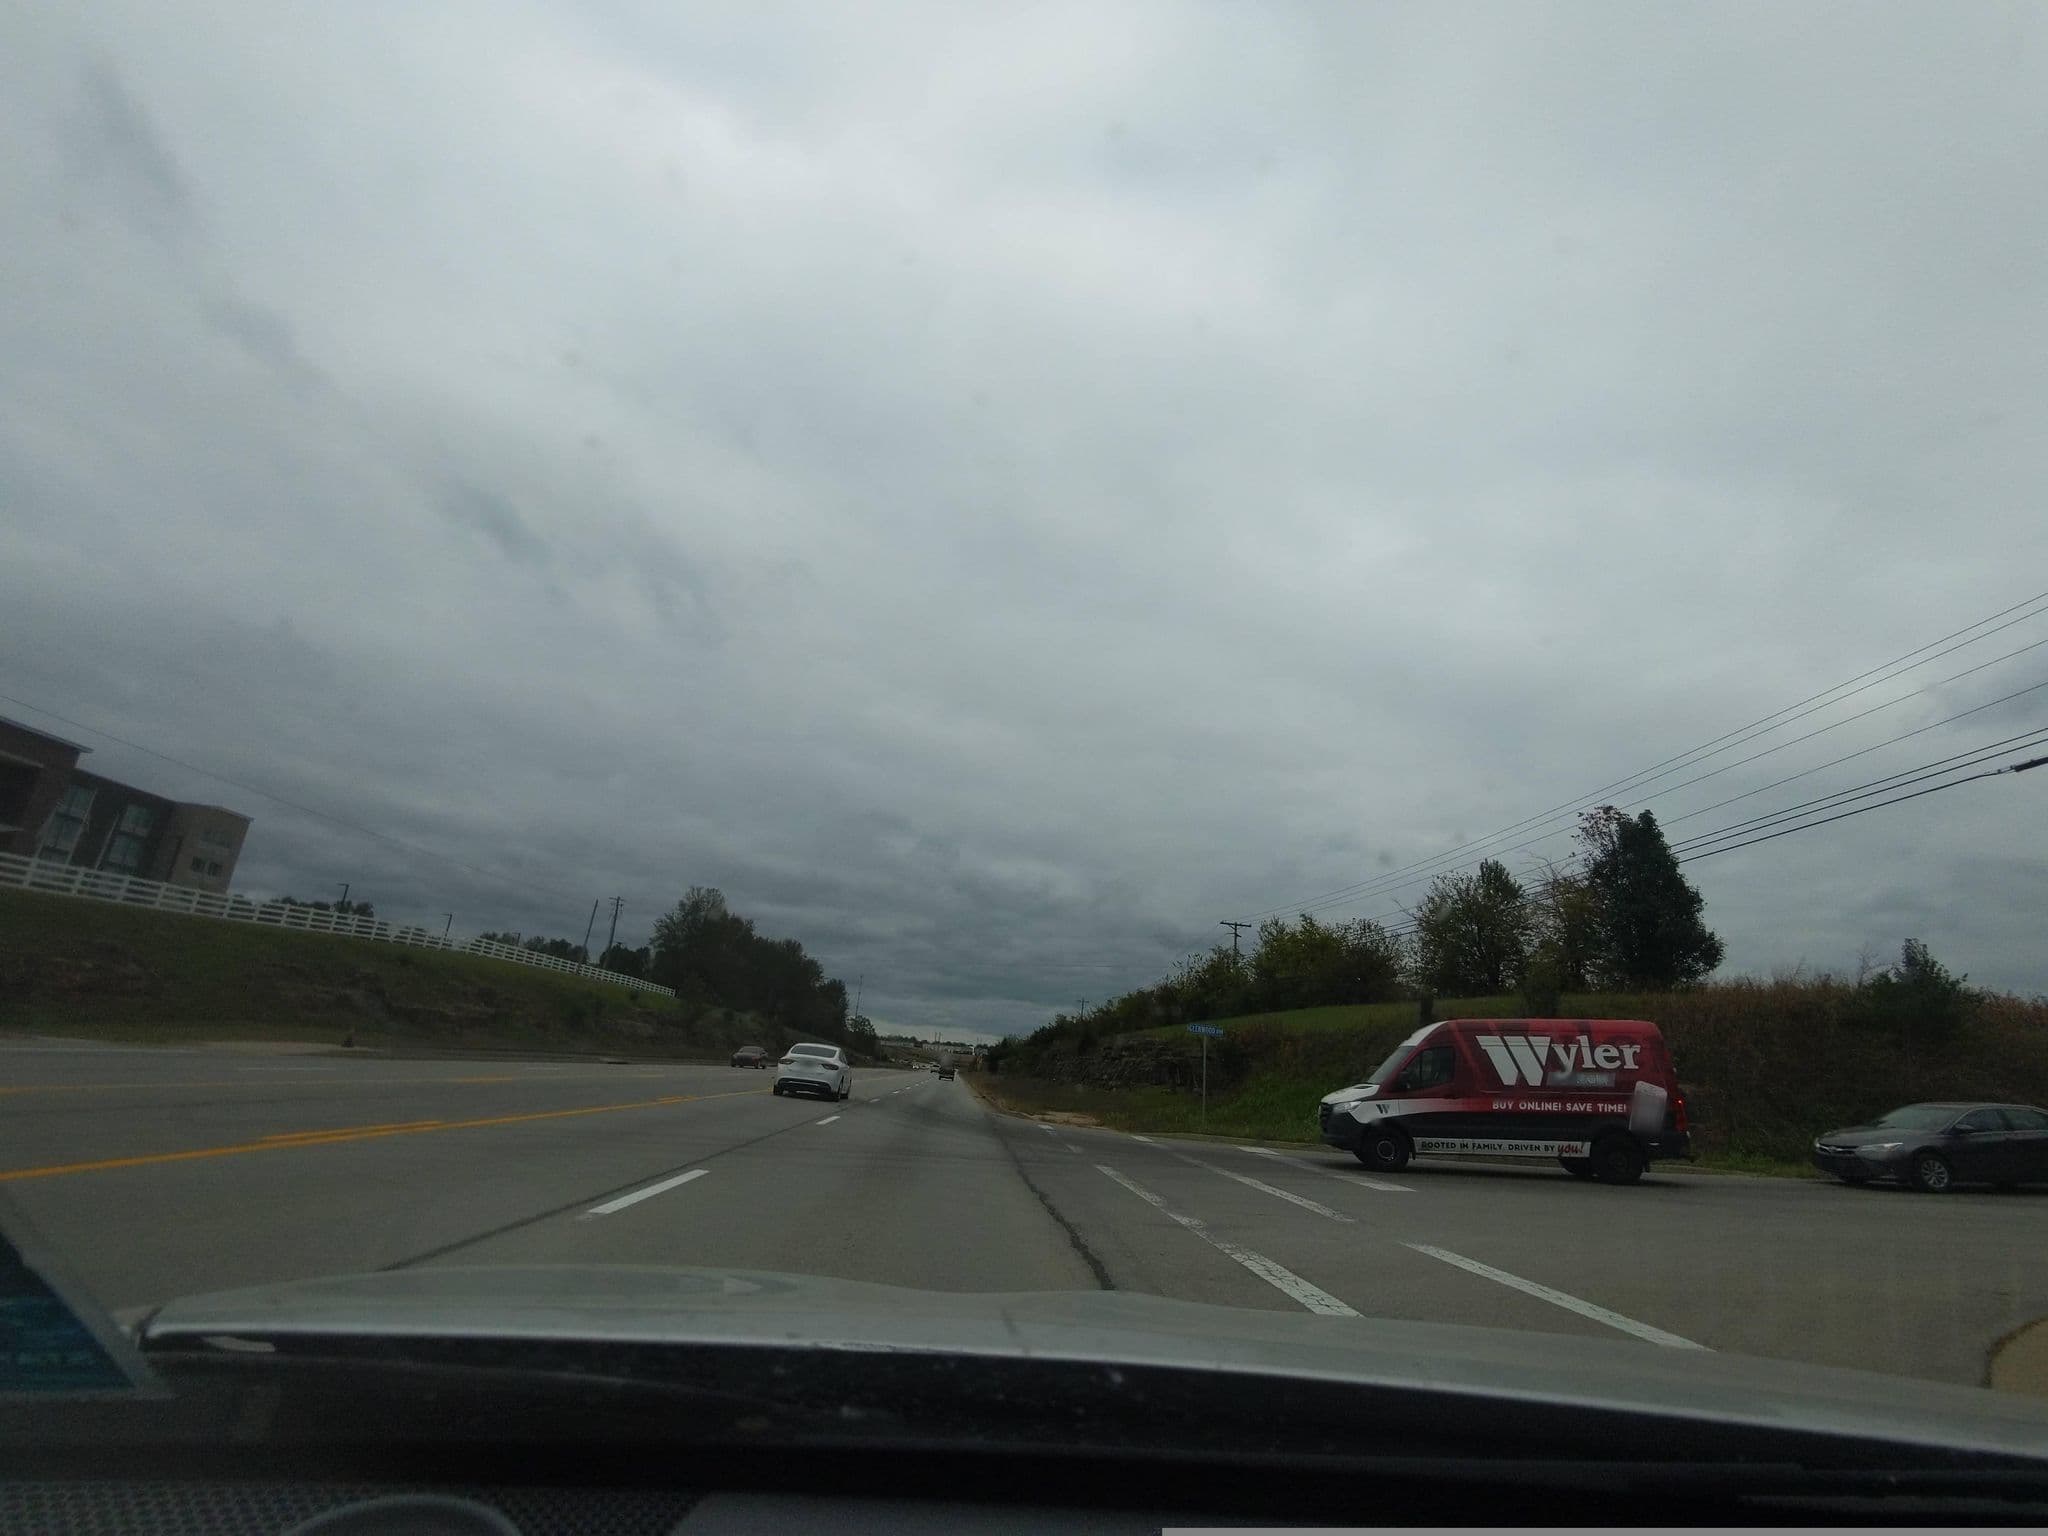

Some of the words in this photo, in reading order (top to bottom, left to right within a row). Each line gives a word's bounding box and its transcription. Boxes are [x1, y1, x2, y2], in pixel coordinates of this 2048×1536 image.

[1475, 1035, 1640, 1086] Wyler
[1492, 1101, 1513, 1111] BUY
[1519, 1102, 1562, 1112] ONLINE!
[1566, 1103, 1593, 1112] SAVE
[1597, 1103, 1627, 1113] TIME!
[1421, 1141, 1456, 1150] ROOTED
[1460, 1142, 1469, 1150] IN
[1508, 1144, 1540, 1152] DRIVEN
[1557, 1143, 1584, 1155] you!
